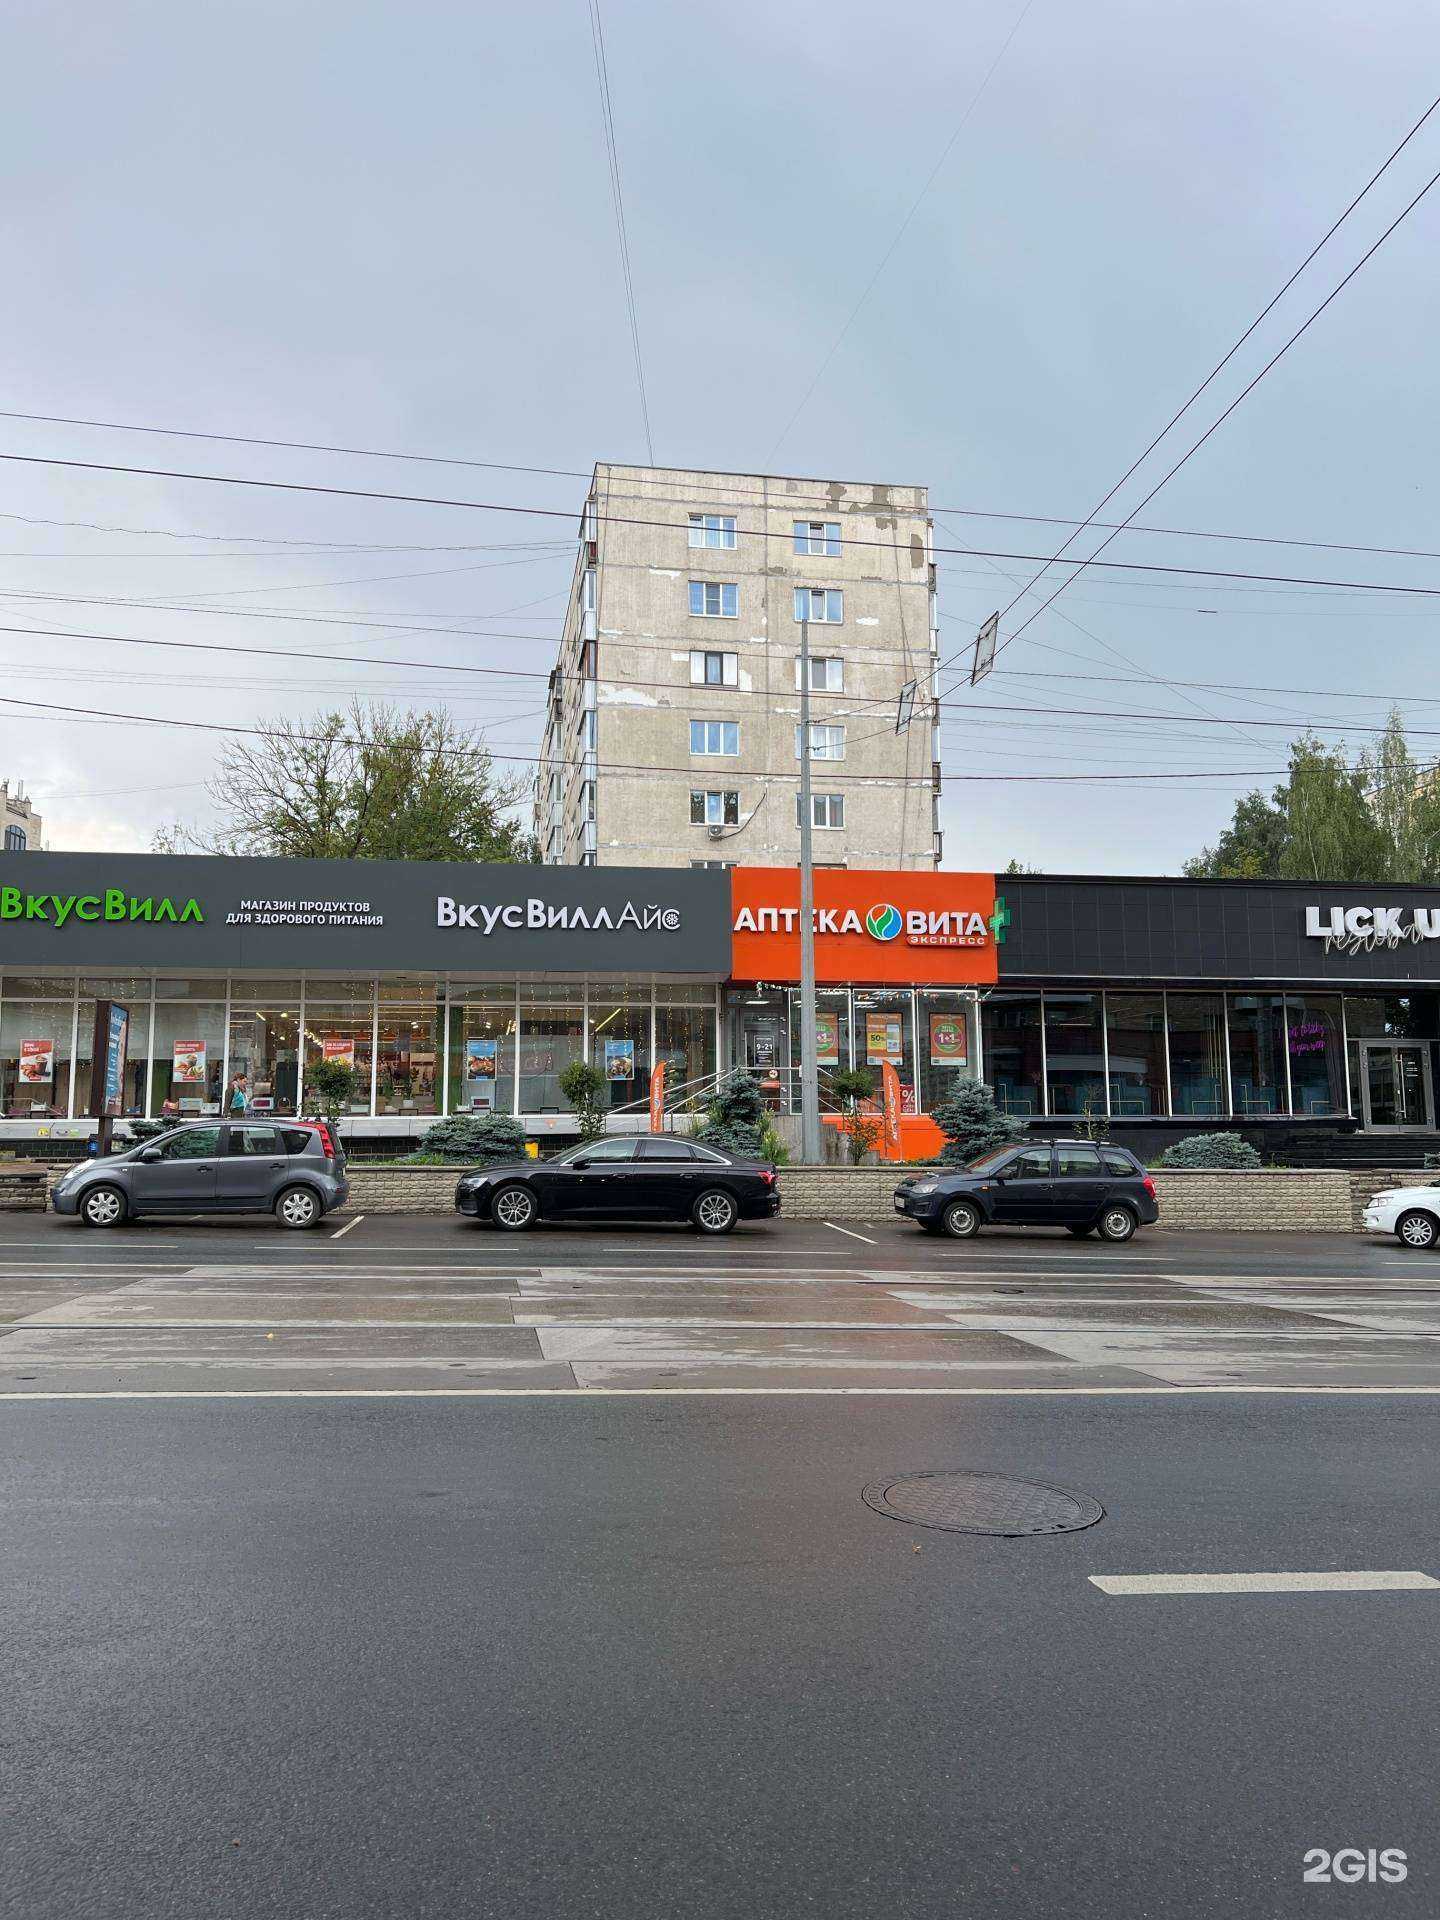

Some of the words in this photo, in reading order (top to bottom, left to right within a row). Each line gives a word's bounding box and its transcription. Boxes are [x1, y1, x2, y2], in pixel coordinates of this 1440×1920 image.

[1, 887, 204, 927] ВкусВилл
[240, 900, 296, 911] МАГАЗИН
[299, 901, 370, 912] ПРОДУКТОВ
[225, 913, 252, 924] ДЛЯ
[254, 913, 326, 925] ЗДОРОВОГО
[328, 915, 384, 926] ПИТАНИЯ
[906, 910, 988, 936] ВИТА
[1305, 906, 1403, 937] LICK
[909, 936, 985, 946] ЭКСПРЕСС
